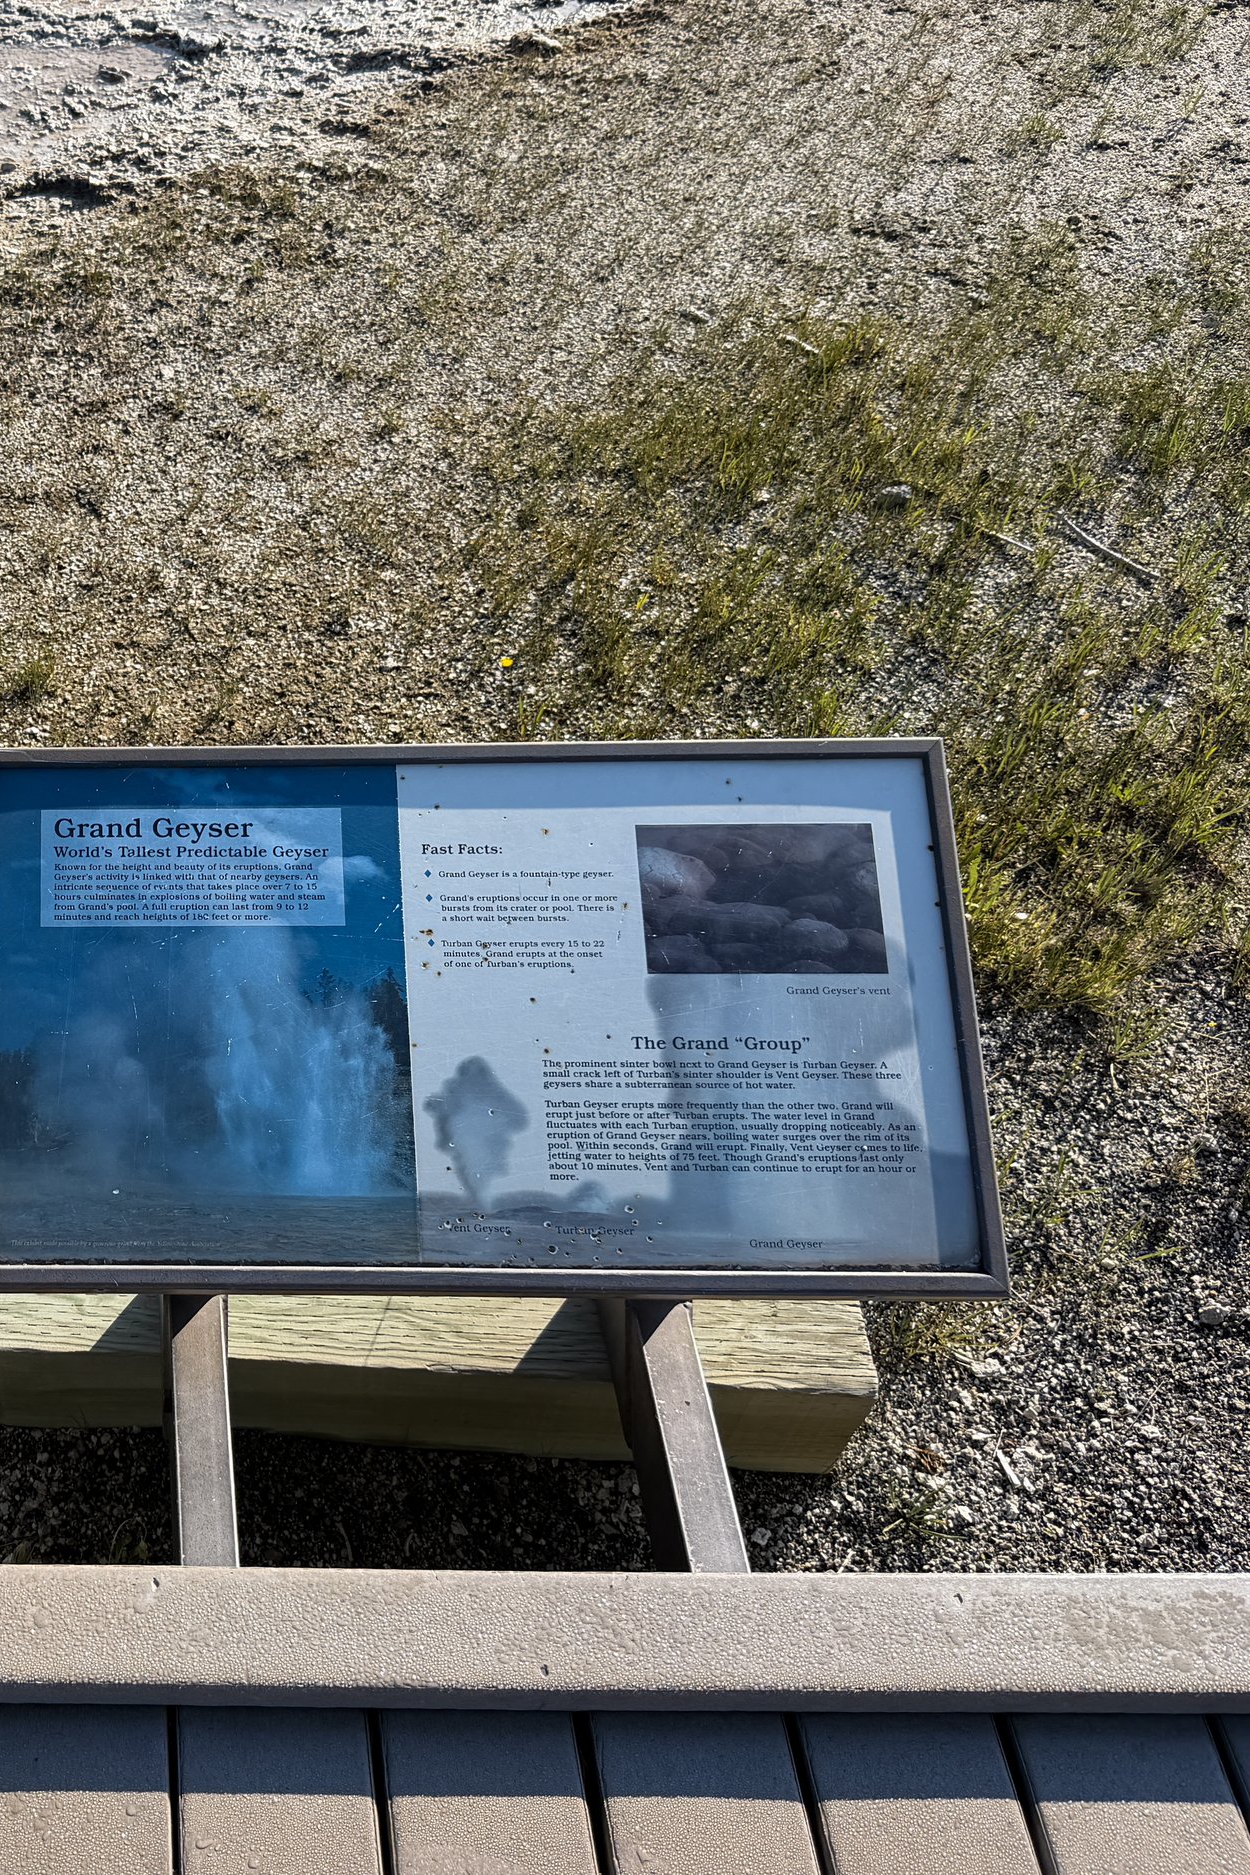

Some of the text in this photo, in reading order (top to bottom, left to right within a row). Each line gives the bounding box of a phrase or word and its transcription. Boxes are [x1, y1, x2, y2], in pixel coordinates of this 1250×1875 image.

[54, 818, 253, 843] Grand Geyser
[118, 845, 170, 858] Tallest
[176, 845, 267, 858] Predictable
[272, 846, 328, 861] Geyser
[421, 844, 502, 854] Fast Facts:
[54, 862, 86, 871] Known
[88, 862, 103, 871] for
[102, 862, 119, 871] the
[122, 862, 152, 872] height
[152, 862, 170, 871] and
[172, 862, 204, 872] beauty
[207, 862, 216, 871] of
[218, 862, 230, 871] its
[283, 862, 312, 871] Grand
[54, 872, 318, 882] Geyser's activity is linked with that of nearby geysers. An
[438, 870, 465, 878] Grand
[468, 870, 498, 880] Geyser
[501, 870, 509, 878] is
[519, 870, 580, 880] fountain-type
[582, 872, 613, 880] geyser.
[54, 892, 326, 902] hours culminates in explosions of boiling water and steam
[476, 894, 520, 903] eruptions
[550, 894, 560, 902] in
[441, 904, 470, 912] bursts
[472, 904, 493, 912] from
[496, 904, 508, 912] its
[510, 904, 537, 912] crater
[552, 904, 575, 913] pool.
[575, 904, 603, 912] There
[606, 904, 614, 912] is
[54, 912, 91, 920] minutes
[94, 912, 111, 920] and
[114, 912, 140, 920] reach
[142, 912, 177, 922] heights
[180, 912, 188, 920] of
[449, 914, 473, 922] short
[476, 914, 494, 922] wait
[497, 914, 536, 922] between
[536, 914, 569, 922] bursts.
[440, 939, 604, 949] Turban Geyser erupts every 15 to 22
[442, 949, 602, 959] minutes. Grand erupts at the onset
[443, 960, 454, 968] of
[474, 960, 486, 968] of
[527, 960, 574, 969] eruptions.
[786, 986, 819, 995] Grand
[867, 986, 890, 995] vent
[631, 1036, 666, 1050] The
[672, 1036, 728, 1050] Grand
[542, 1060, 887, 1071] The prominent sinter bowl next to Grand Geyser is Turban Geyser. A
[543, 1082, 581, 1090] geysers
[584, 1080, 612, 1089] share
[624, 1080, 691, 1089] subterranean
[732, 1080, 742, 1089] of
[745, 1080, 762, 1089] hot
[765, 1080, 795, 1089] water.
[545, 1100, 580, 1109] Turban
[583, 1100, 618, 1111] Geyser
[621, 1101, 654, 1111] erupts
[686, 1101, 738, 1111] frequently
[741, 1101, 764, 1110] than
[767, 1102, 784, 1110] the
[786, 1102, 814, 1110] other
[817, 1102, 839, 1110] two.
[841, 1102, 874, 1110] Grand
[875, 1102, 893, 1111] will
[546, 1120, 597, 1129] fluctuates
[600, 1121, 622, 1129] with
[625, 1121, 648, 1129] each
[650, 1121, 687, 1130] Turban
[691, 1121, 737, 1132] eruption,
[741, 1122, 777, 1132] usually
[781, 1122, 826, 1132] dropping
[830, 1122, 885, 1133] noticeably.
[888, 1123, 900, 1131] As
[750, 1239, 823, 1250] Grand Geyser
